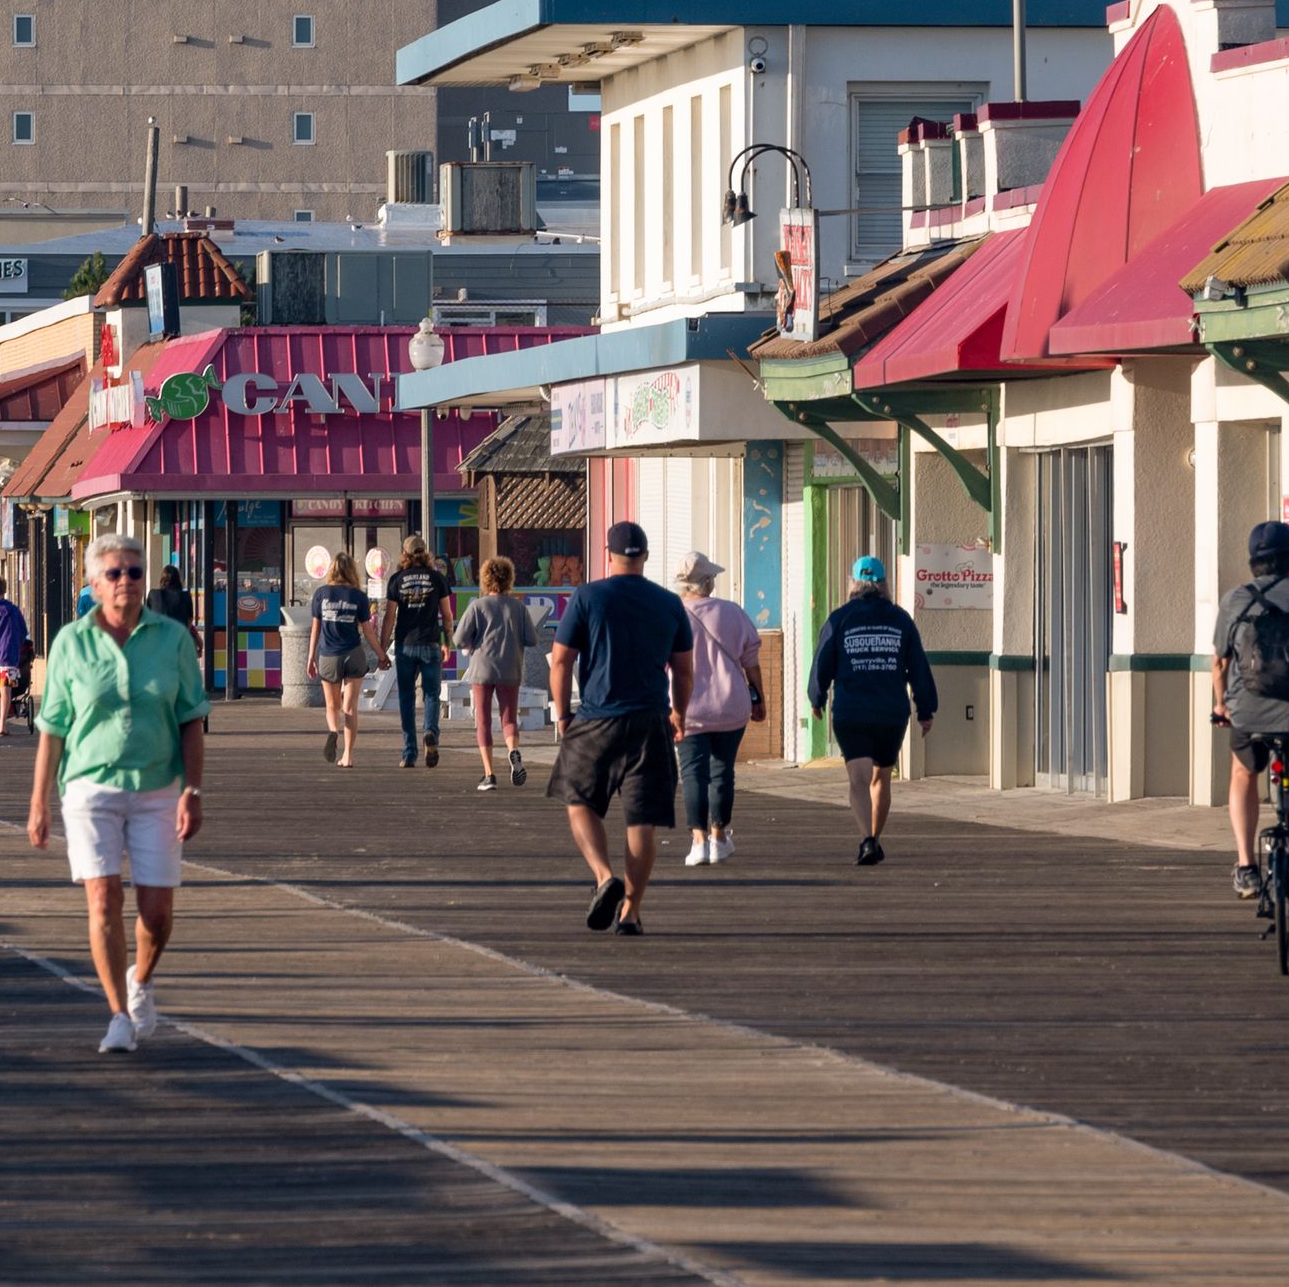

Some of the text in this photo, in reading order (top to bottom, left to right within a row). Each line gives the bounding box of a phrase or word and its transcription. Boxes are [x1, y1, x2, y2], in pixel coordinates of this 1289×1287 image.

[308, 499, 404, 511] CANDY KITCHEN
[916, 568, 960, 582] Grotto
